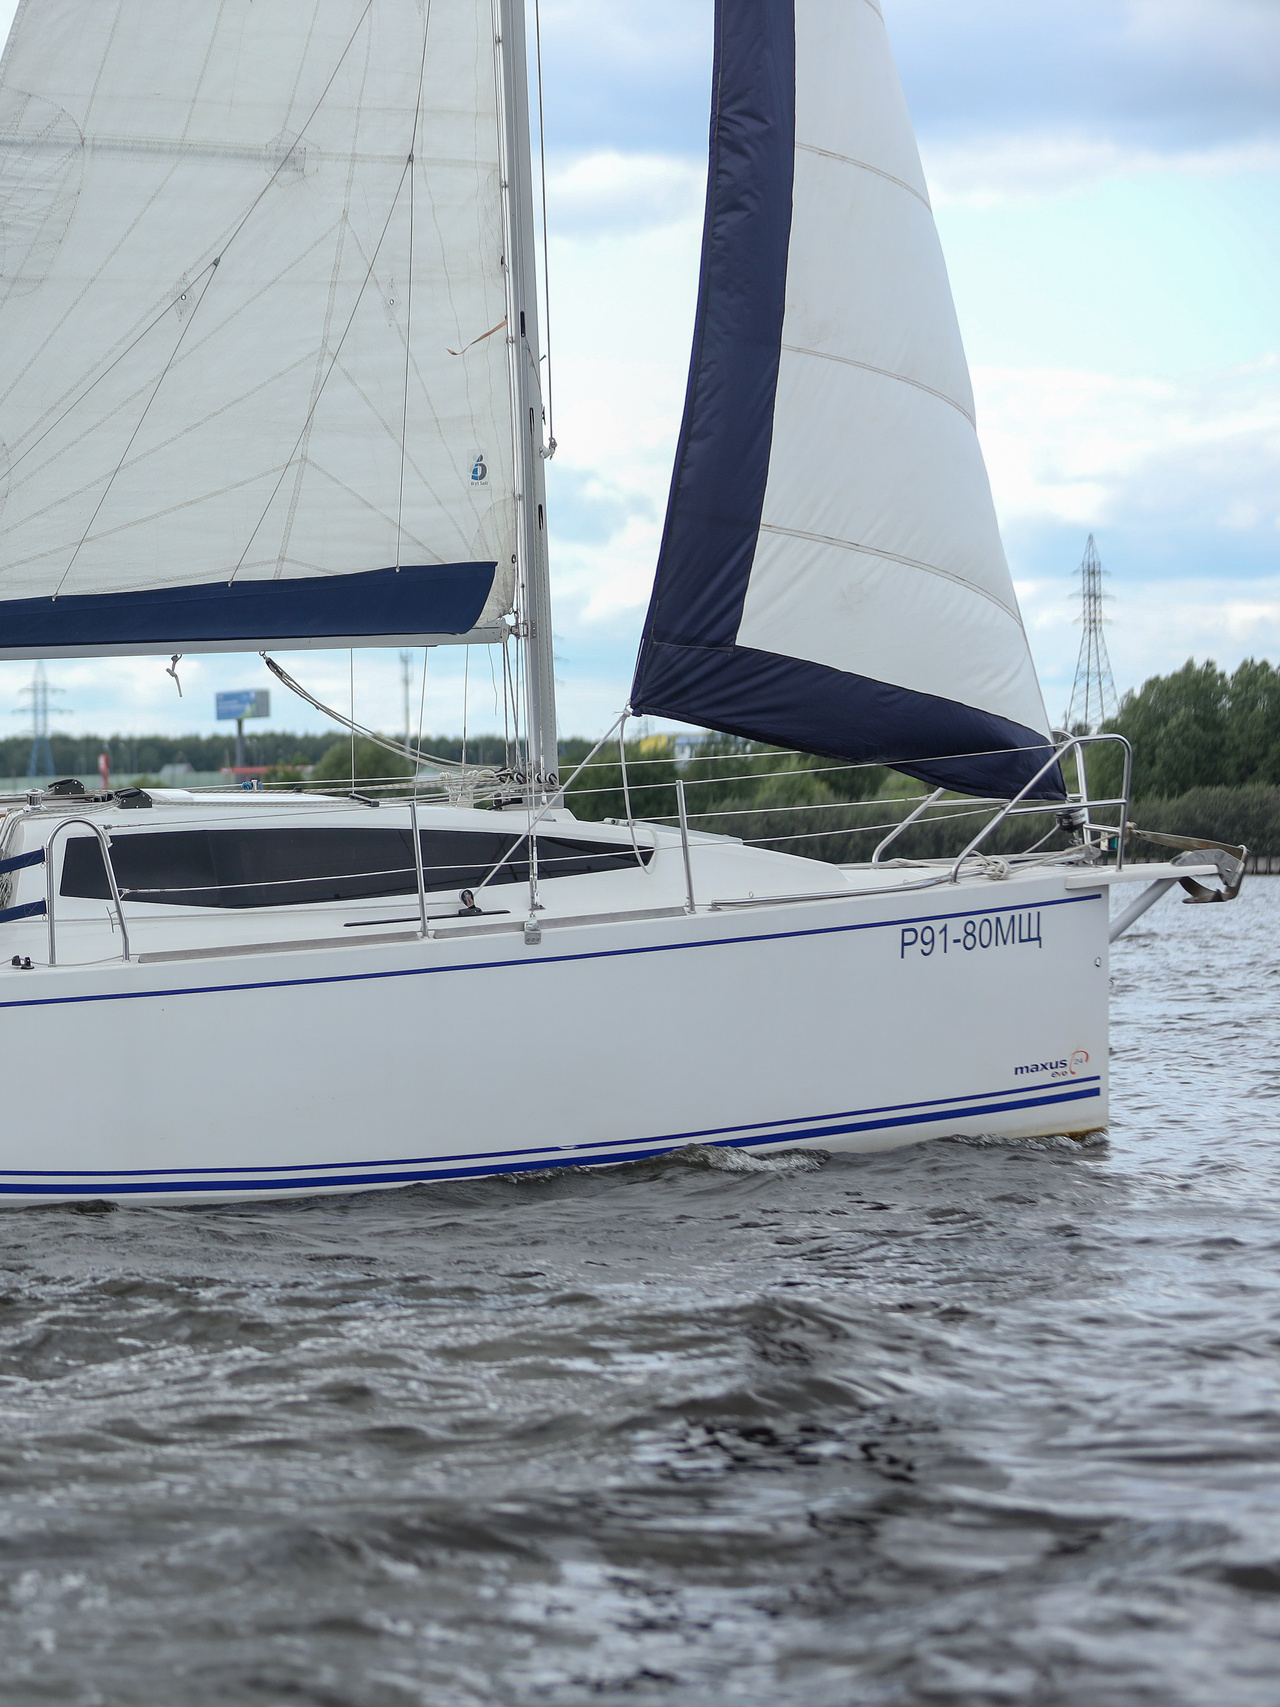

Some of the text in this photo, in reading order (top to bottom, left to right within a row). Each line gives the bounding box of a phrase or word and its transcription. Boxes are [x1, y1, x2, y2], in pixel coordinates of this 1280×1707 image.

[900, 911, 1042, 959] Р91-80МЩ
[1014, 1059, 1068, 1076] maxus
[1051, 1070, 1068, 1078] evo
